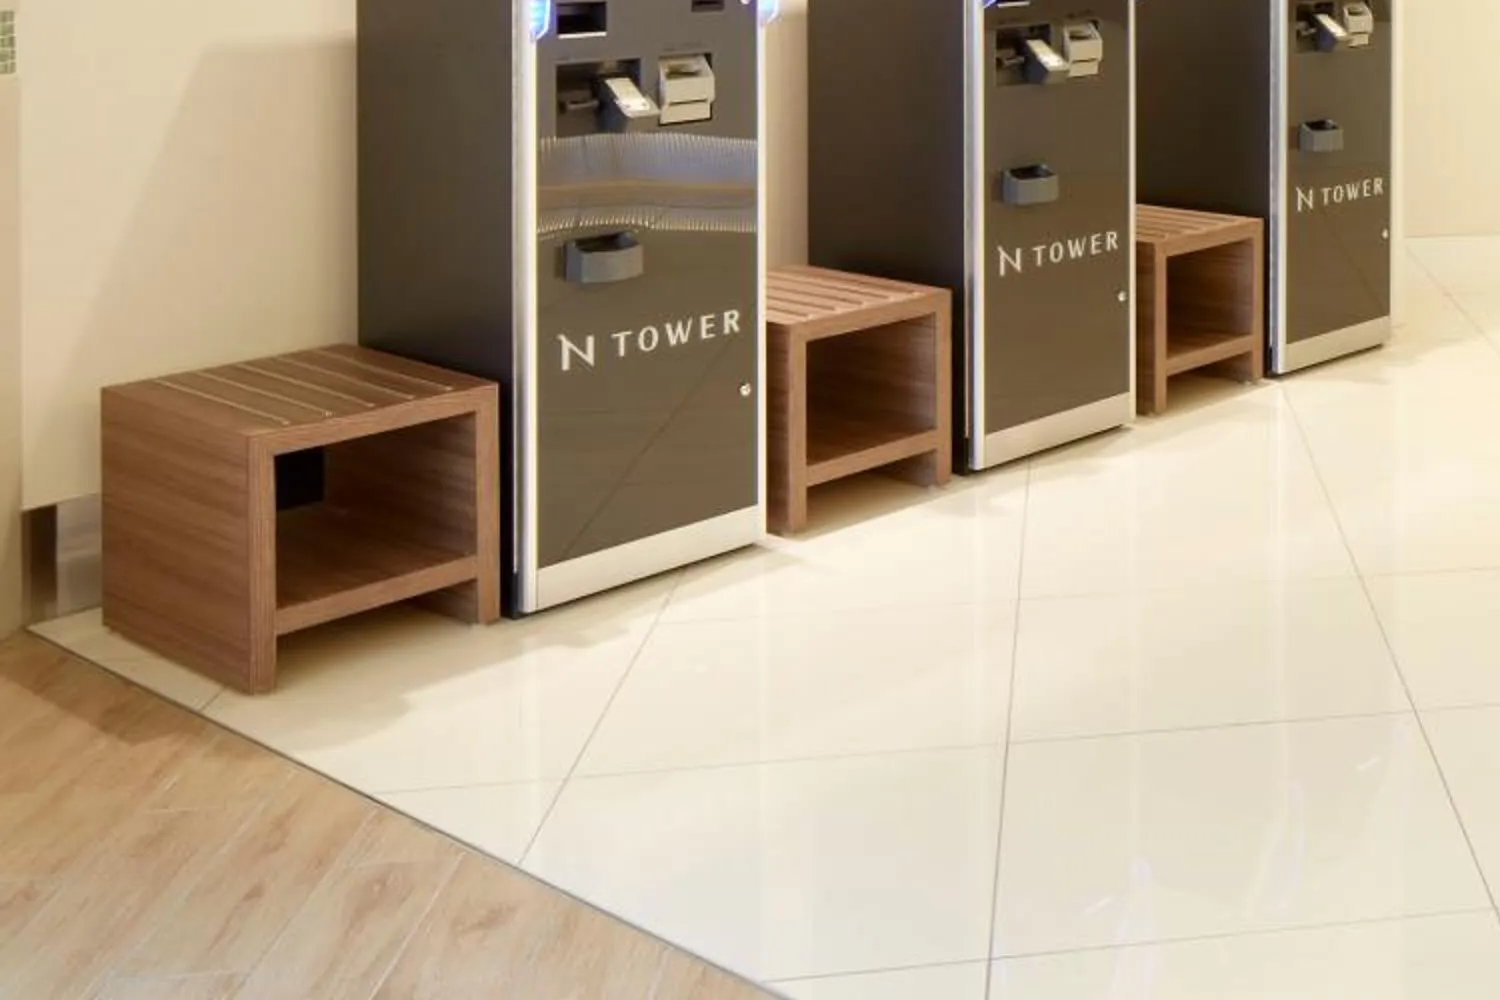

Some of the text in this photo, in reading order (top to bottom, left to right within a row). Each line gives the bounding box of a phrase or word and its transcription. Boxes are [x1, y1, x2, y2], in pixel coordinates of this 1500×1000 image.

[1295, 177, 1384, 213] N TOWER
[997, 231, 1119, 277] N TOWER
[557, 309, 740, 372] N TOWER
